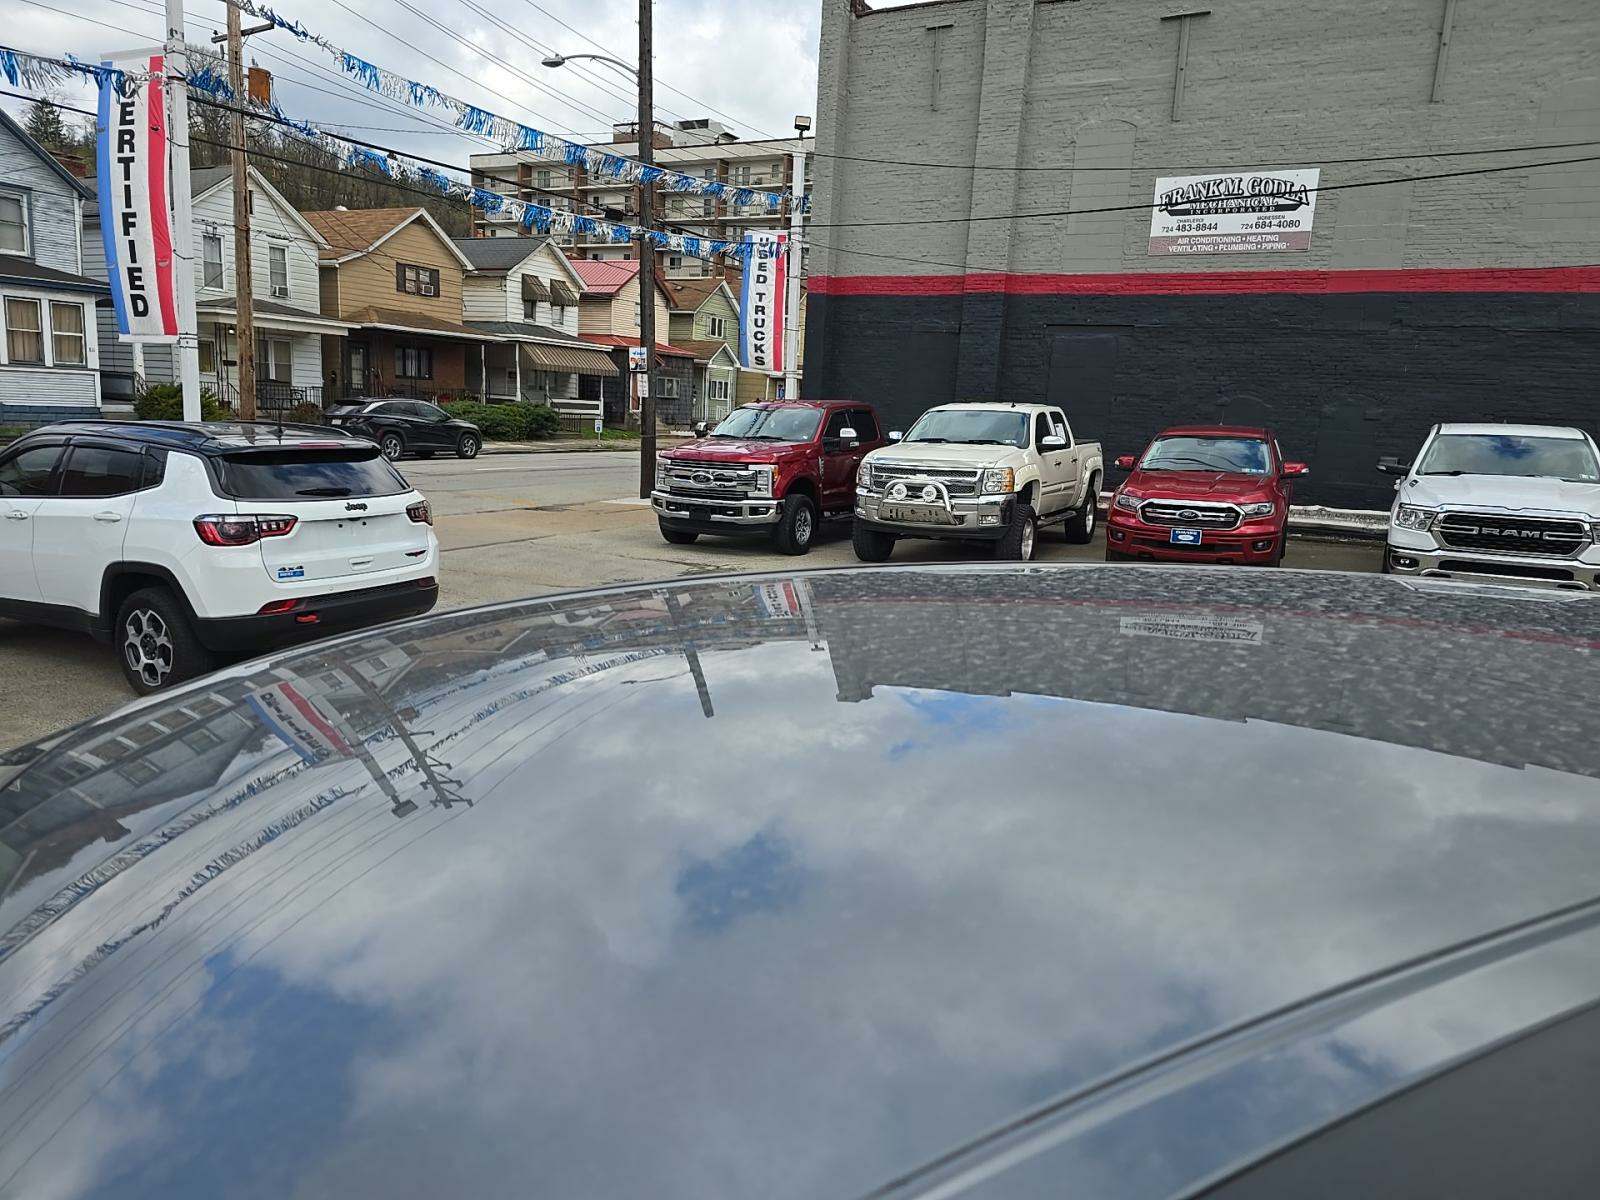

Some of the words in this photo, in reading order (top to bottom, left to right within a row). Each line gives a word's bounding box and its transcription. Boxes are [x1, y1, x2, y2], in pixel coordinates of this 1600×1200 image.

[1159, 179, 1223, 211] FRANK
[1224, 177, 1243, 197] M.
[1246, 176, 1310, 206] GODLA
[1190, 197, 1279, 211] MECHANICAL
[1189, 207, 1275, 215] INCORPORATED
[1174, 222, 1218, 232] 483-8844
[1254, 219, 1301, 230] 684-4080
[1190, 235, 1242, 244] CONDITIONING
[1246, 234, 1279, 242] HEATING
[1168, 244, 1214, 252] VENTILATING
[1218, 243, 1257, 251] PLUMBING
[756, 237, 769, 284] USED
[753, 292, 767, 366] TRUCKS
[345, 502, 368, 512] Jeep
[1481, 527, 1541, 540] RAM
